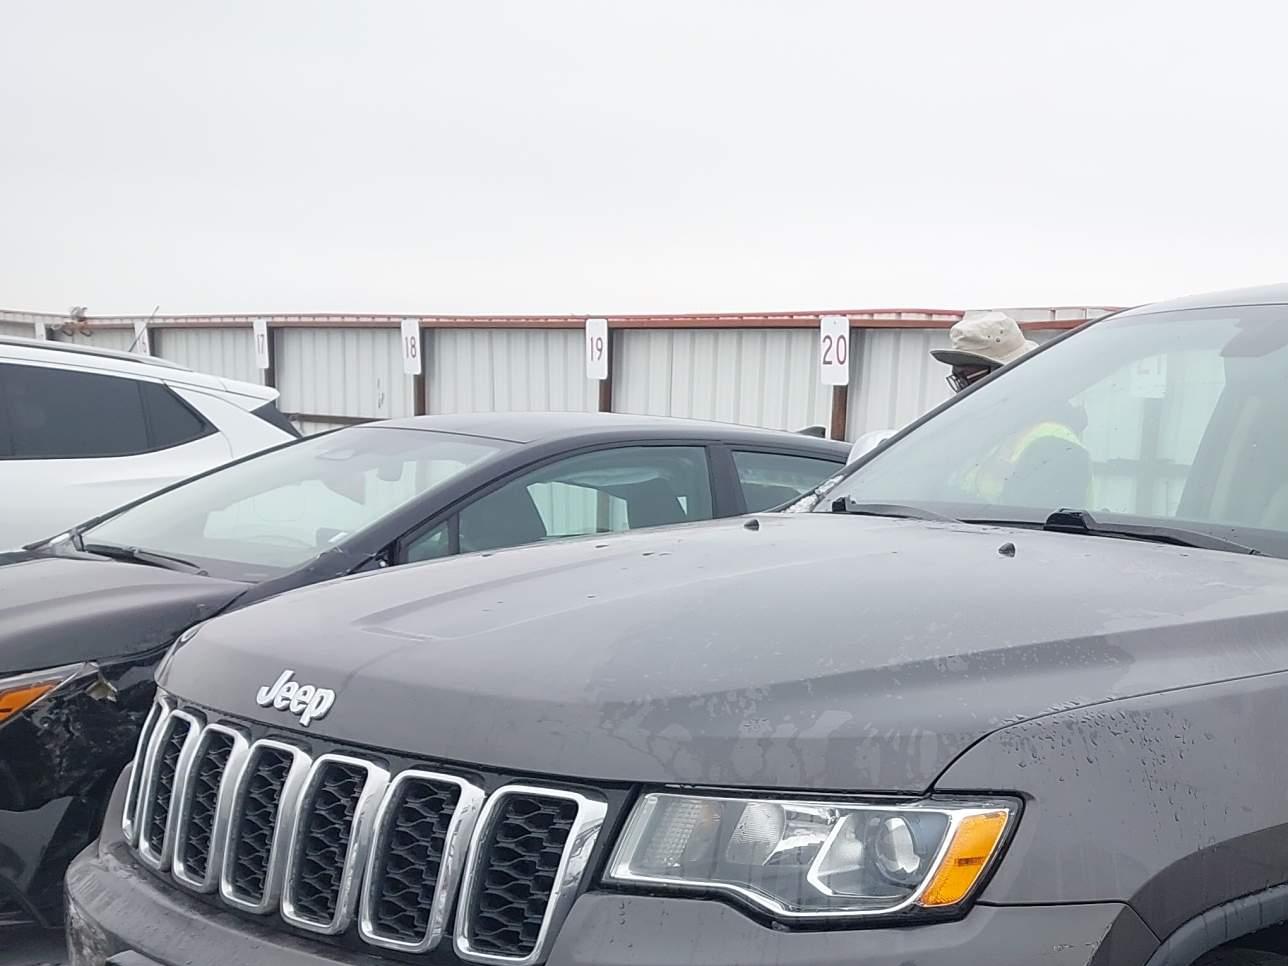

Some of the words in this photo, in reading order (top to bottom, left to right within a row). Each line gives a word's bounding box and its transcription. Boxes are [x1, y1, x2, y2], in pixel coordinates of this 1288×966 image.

[404, 335, 417, 359] 18
[589, 336, 604, 361] 19
[822, 334, 847, 365] 20
[256, 670, 336, 727] Jeep
